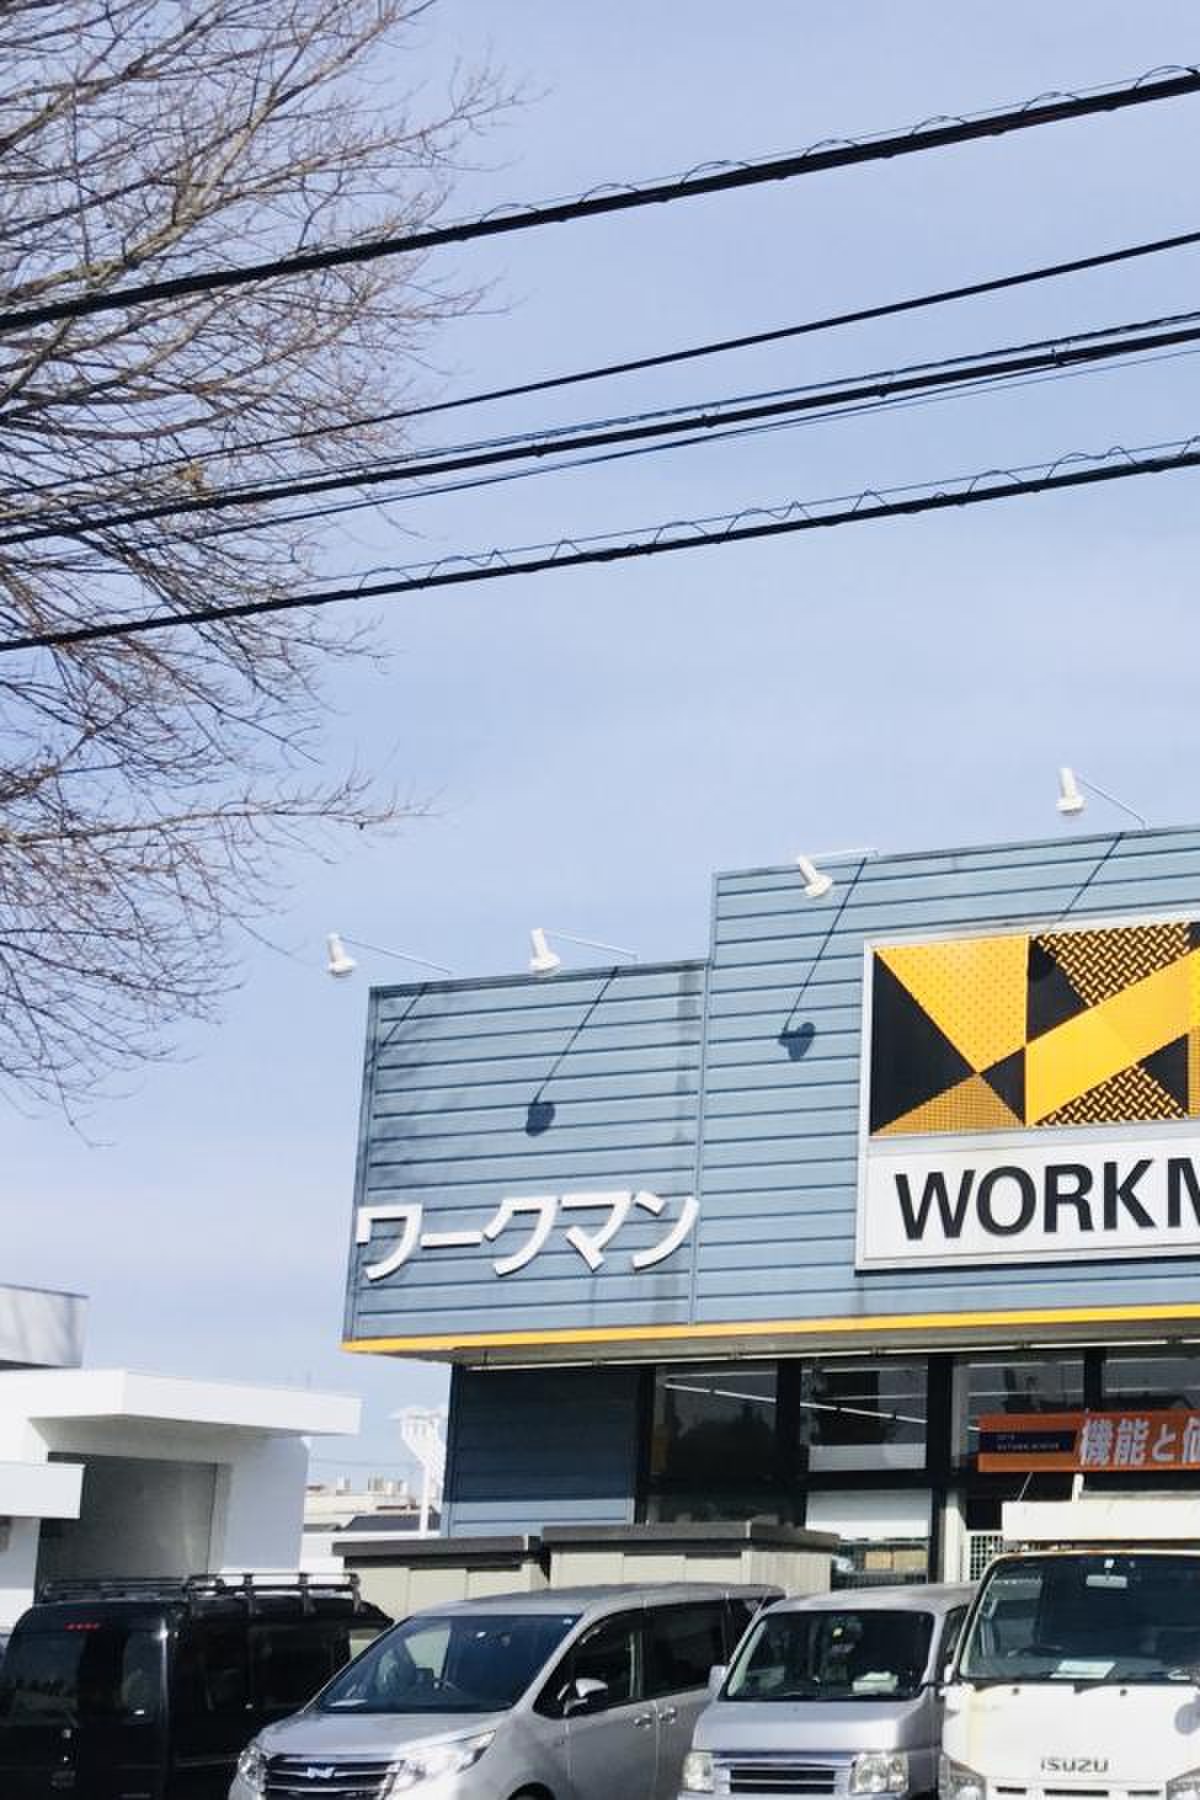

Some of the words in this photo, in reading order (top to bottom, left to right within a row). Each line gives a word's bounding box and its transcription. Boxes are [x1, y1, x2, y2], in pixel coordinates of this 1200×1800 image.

[355, 1190, 700, 1281] ワークマン
[1040, 1757, 1109, 1773] ISUZU
